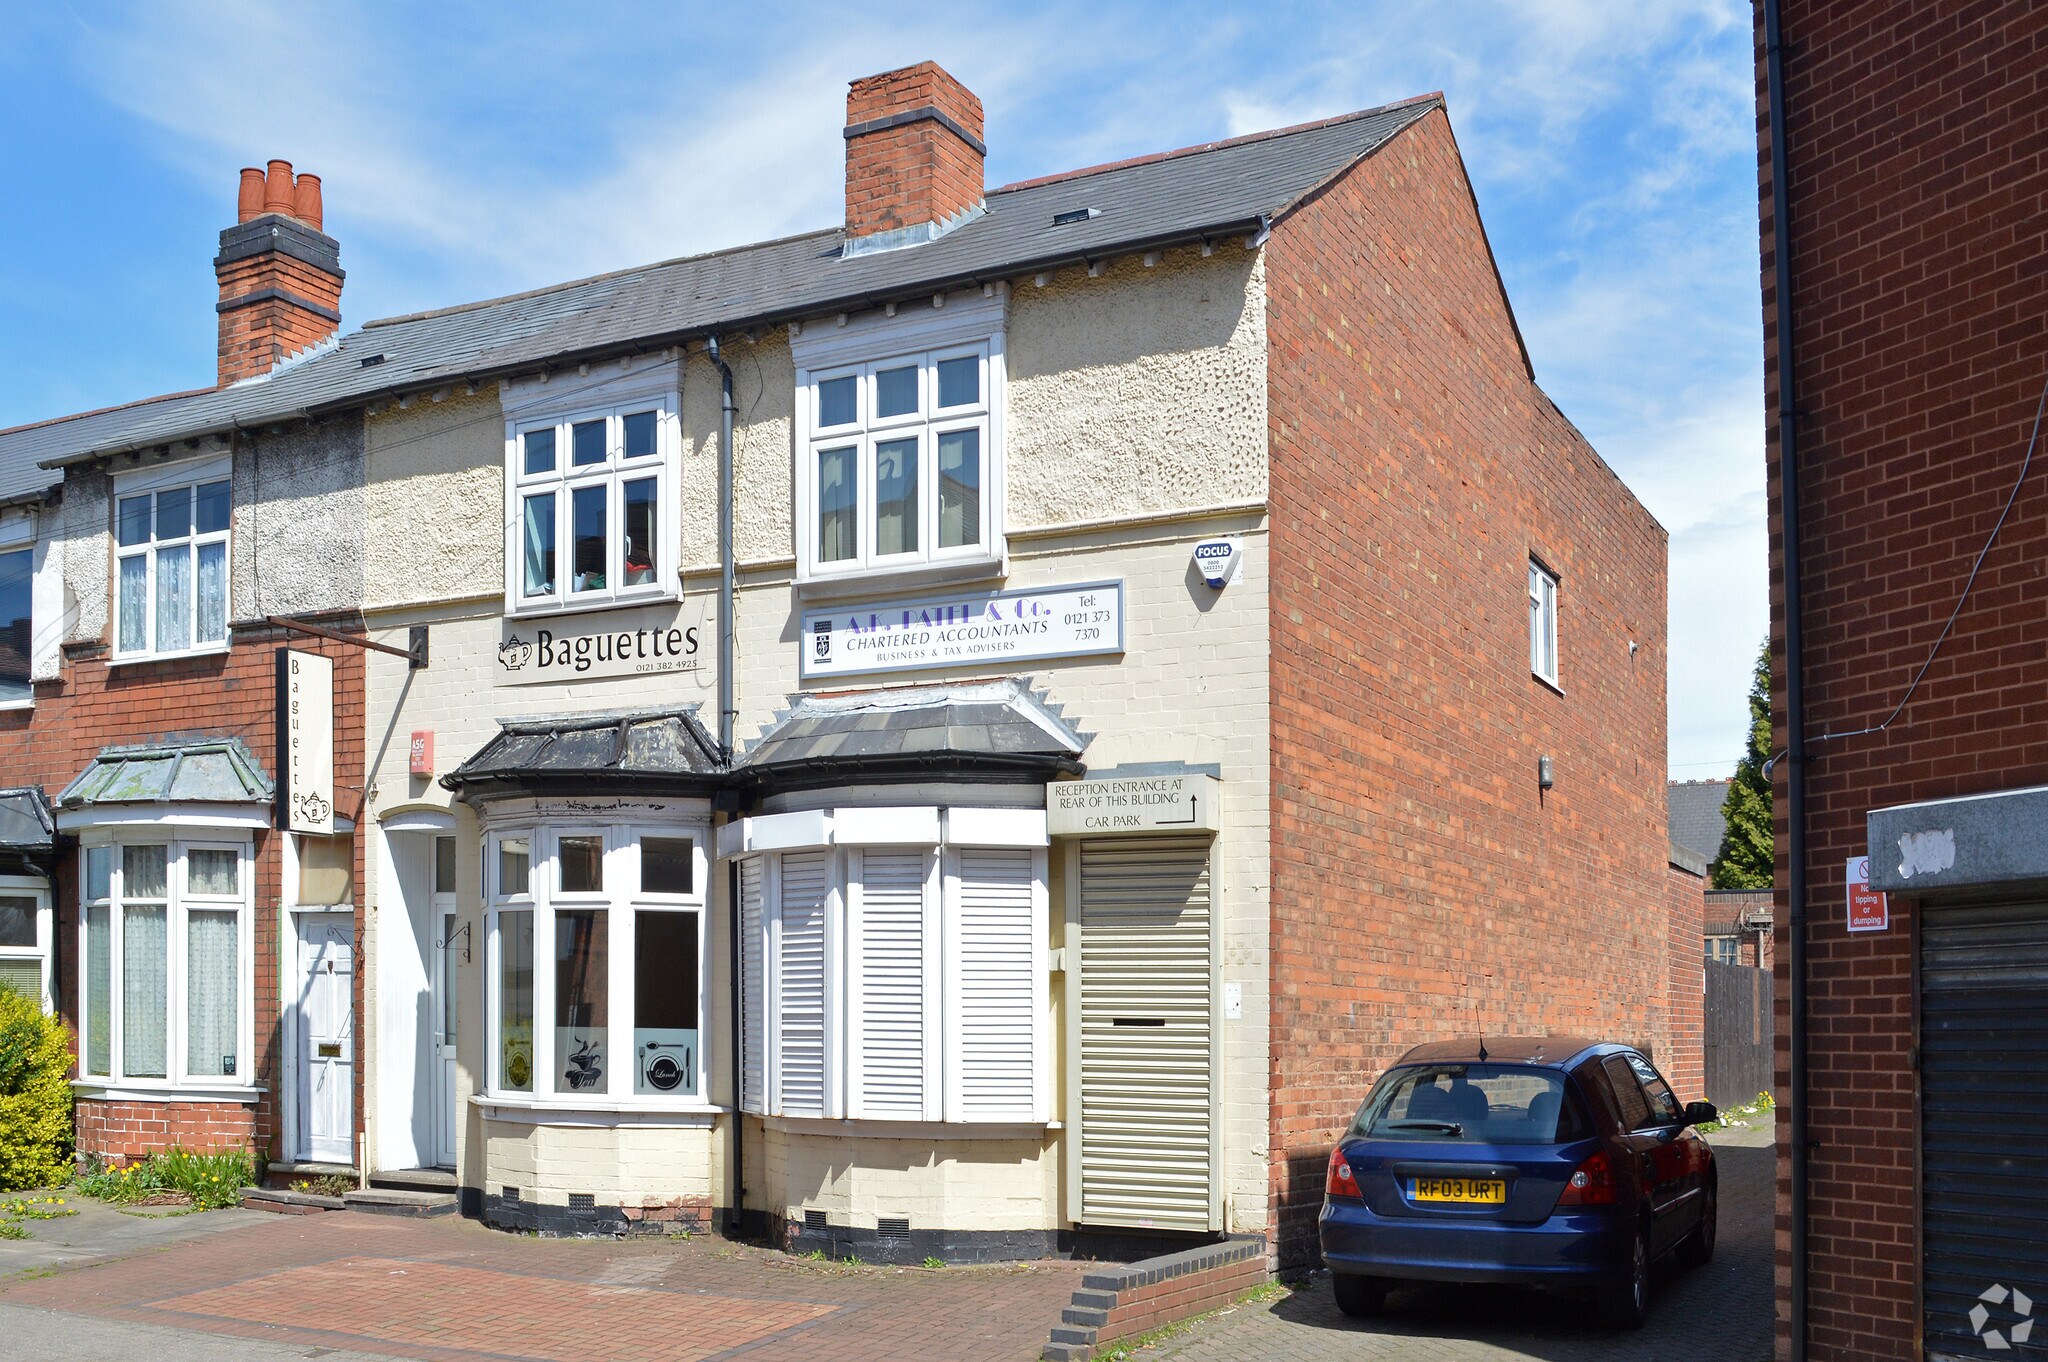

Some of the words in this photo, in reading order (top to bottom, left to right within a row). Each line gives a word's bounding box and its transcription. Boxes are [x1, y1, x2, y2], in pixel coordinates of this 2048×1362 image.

[1198, 546, 1229, 557] FOCUS
[1078, 594, 1096, 607] Tel:
[844, 613, 891, 635] A.K.
[902, 604, 975, 629] PATEL
[986, 601, 1003, 622] &
[1014, 598, 1051, 619] Co.
[1064, 613, 1087, 625] 0121
[1092, 610, 1110, 622] 373
[847, 632, 930, 651] CHARTERED
[937, 620, 1048, 642] ACCOUNTANTS
[1075, 627, 1100, 640] 7370
[537, 626, 698, 672] Baguettes
[877, 649, 926, 661] BUSINESS
[931, 648, 938, 657] &
[944, 646, 962, 655] TAX
[967, 641, 1015, 653] ADVISERS
[636, 664, 654, 672] 0121
[656, 661, 673, 670] 382
[676, 660, 697, 668] 4925
[291, 659, 300, 822] Baguettes
[1055, 783, 1109, 797] RECEPTION
[1112, 780, 1167, 794] ENTRANCE
[1171, 779, 1183, 790] AT
[1060, 798, 1085, 809] REAR
[1088, 796, 1102, 807] OF
[1106, 795, 1127, 806] THIS
[1132, 793, 1179, 806] BUILDING
[1085, 816, 1109, 828] CAR
[1113, 815, 1141, 826] PARK
[1855, 895, 1878, 905] tipping
[1854, 915, 1881, 925] dumping
[1419, 1180, 1463, 1198] RF03
[1468, 1181, 1502, 1199] URT
